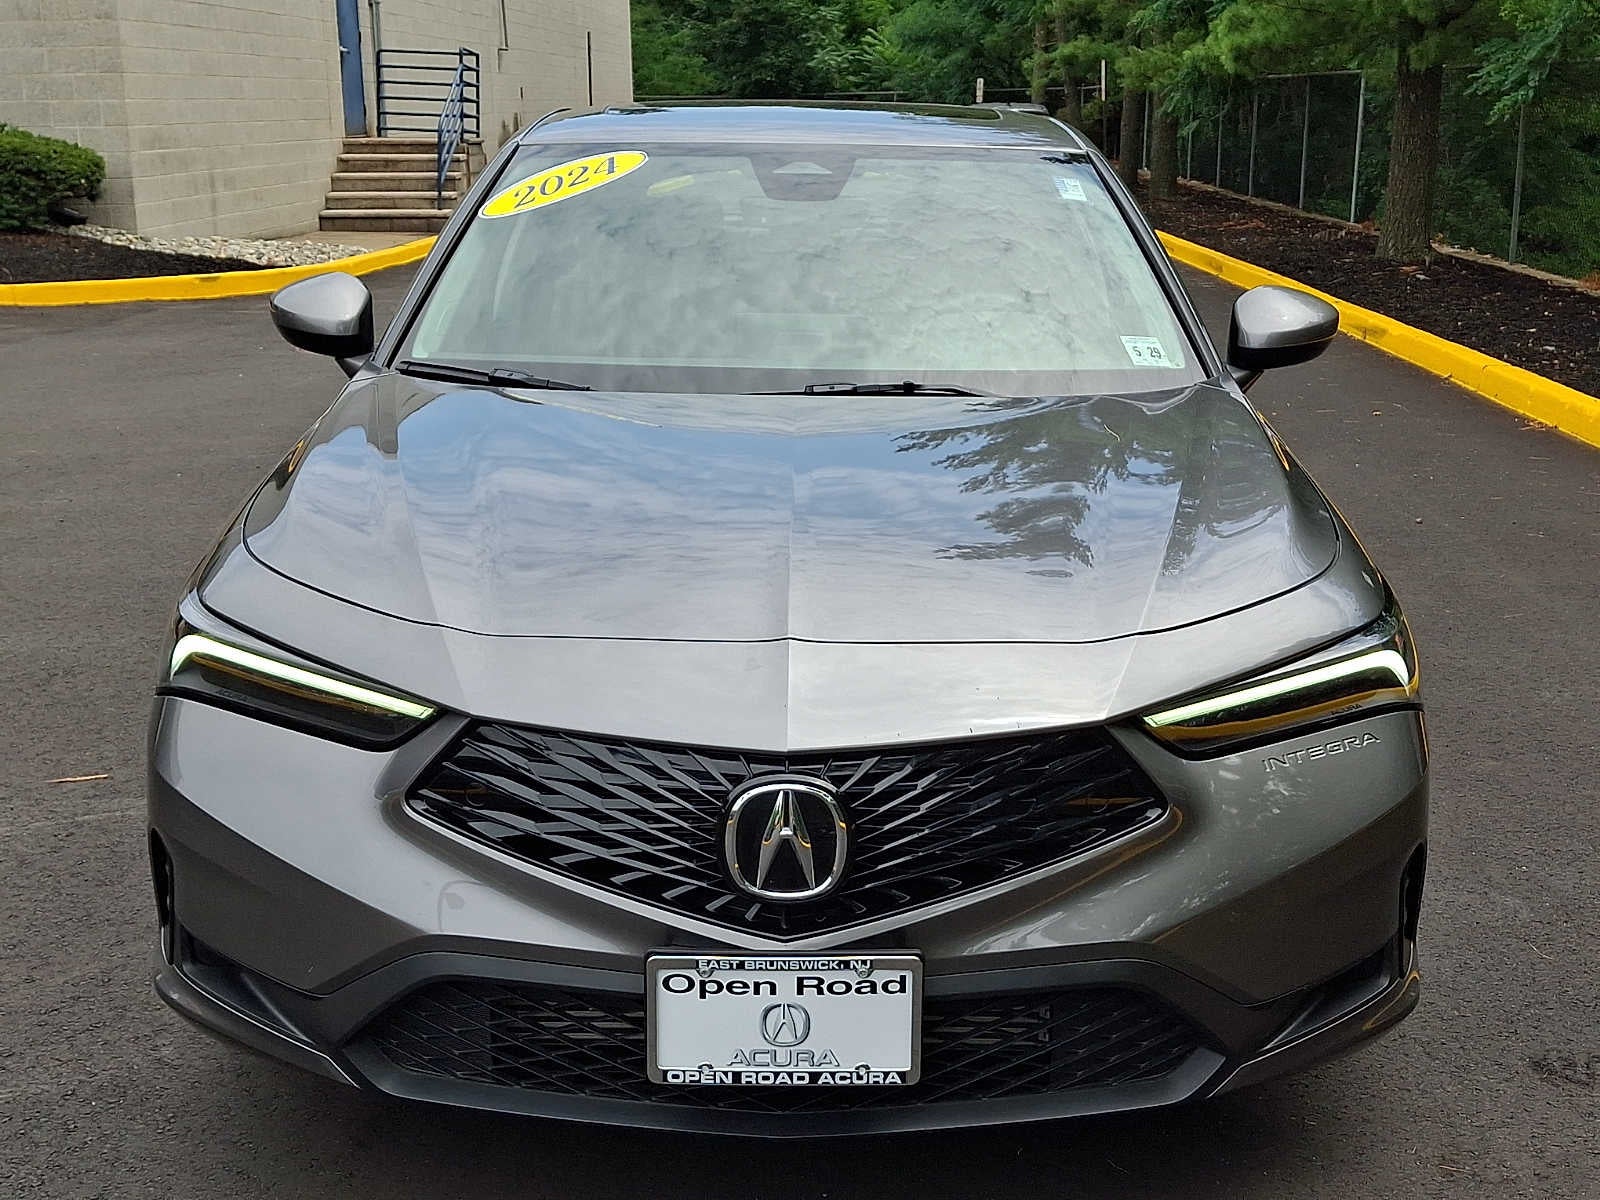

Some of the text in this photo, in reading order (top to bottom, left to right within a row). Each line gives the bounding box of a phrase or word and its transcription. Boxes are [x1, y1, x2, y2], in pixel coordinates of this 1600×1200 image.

[514, 156, 617, 209] 2024
[1133, 346, 1162, 359] 5 29
[1263, 732, 1381, 772] INTEGRA
[699, 960, 739, 970] EAST
[851, 960, 871, 970] NJ
[662, 974, 907, 999] Open Road
[728, 1048, 840, 1067] ACURA
[666, 1071, 902, 1085] OPEN ROAD ACURA
